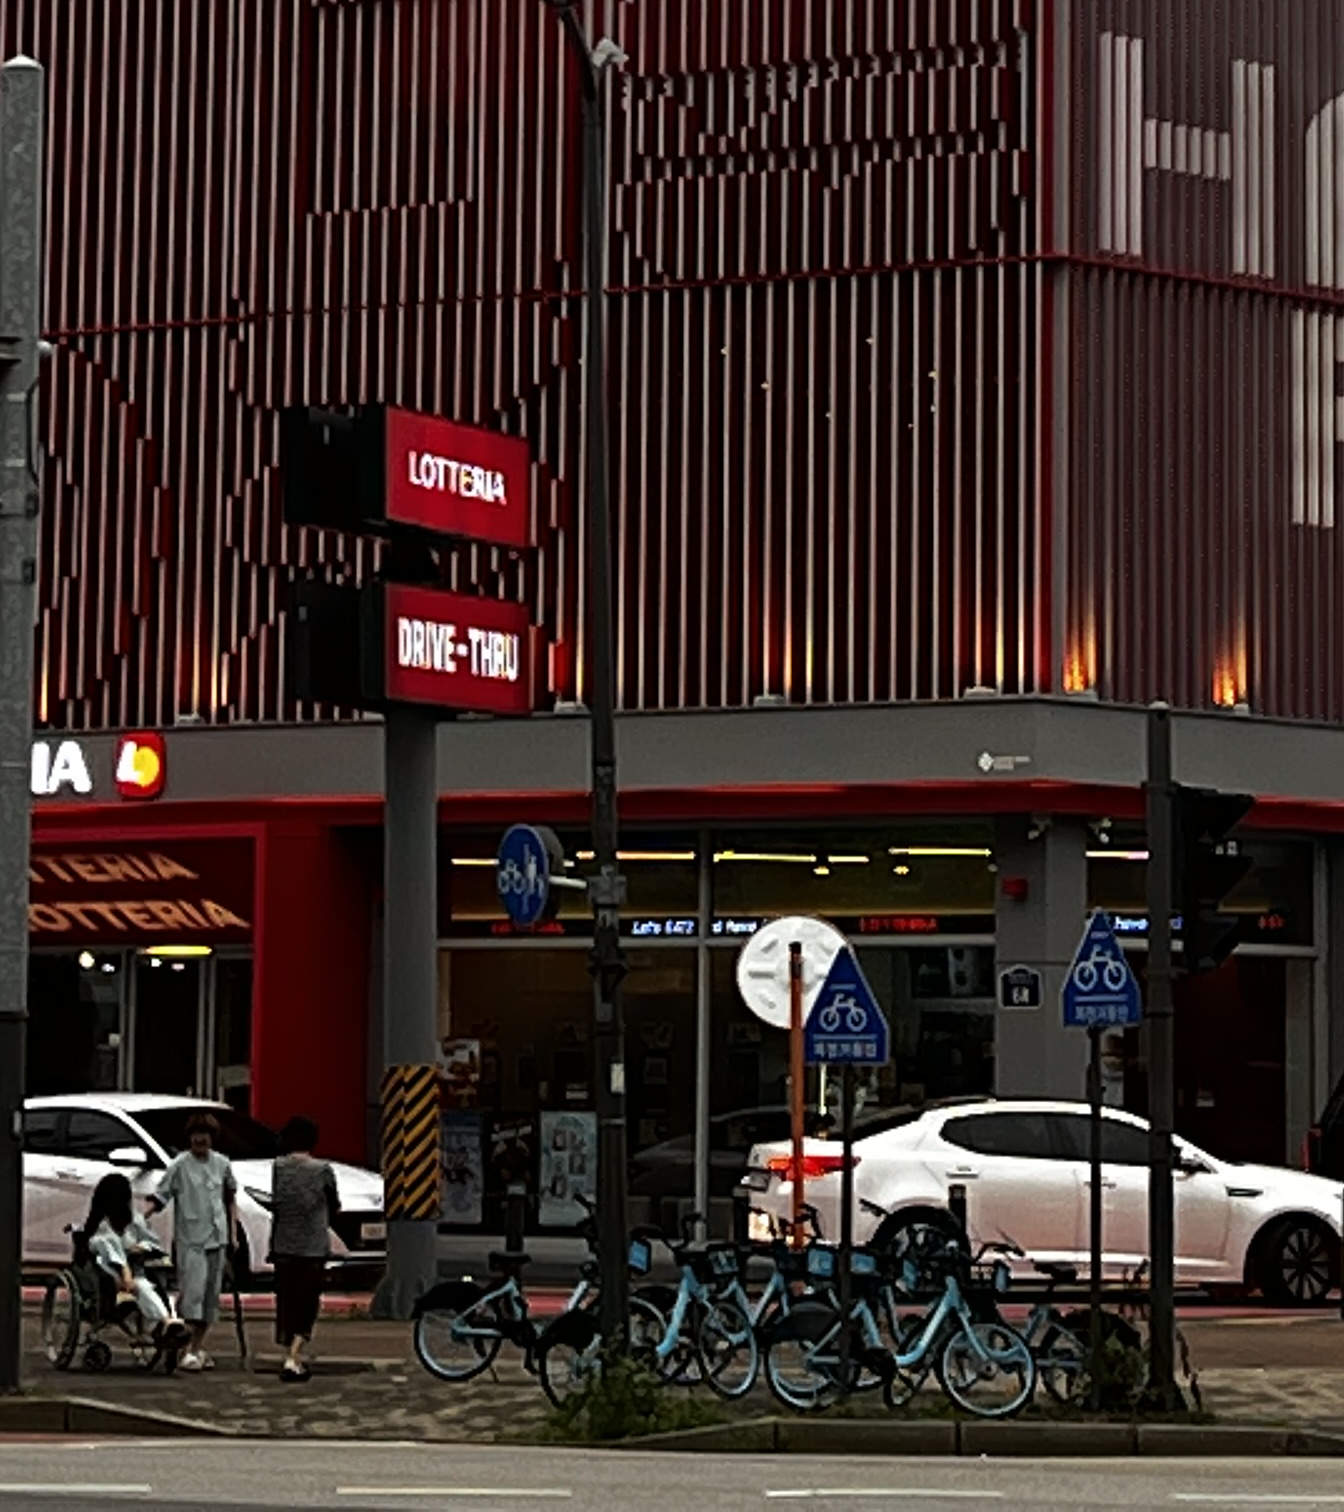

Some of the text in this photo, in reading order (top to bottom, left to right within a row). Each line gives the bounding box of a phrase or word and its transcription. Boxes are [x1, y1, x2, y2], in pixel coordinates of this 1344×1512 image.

[408, 450, 508, 506] LOTTERIA
[398, 617, 520, 682] DRIVE-THRU
[29, 897, 253, 932] OTTERIA
